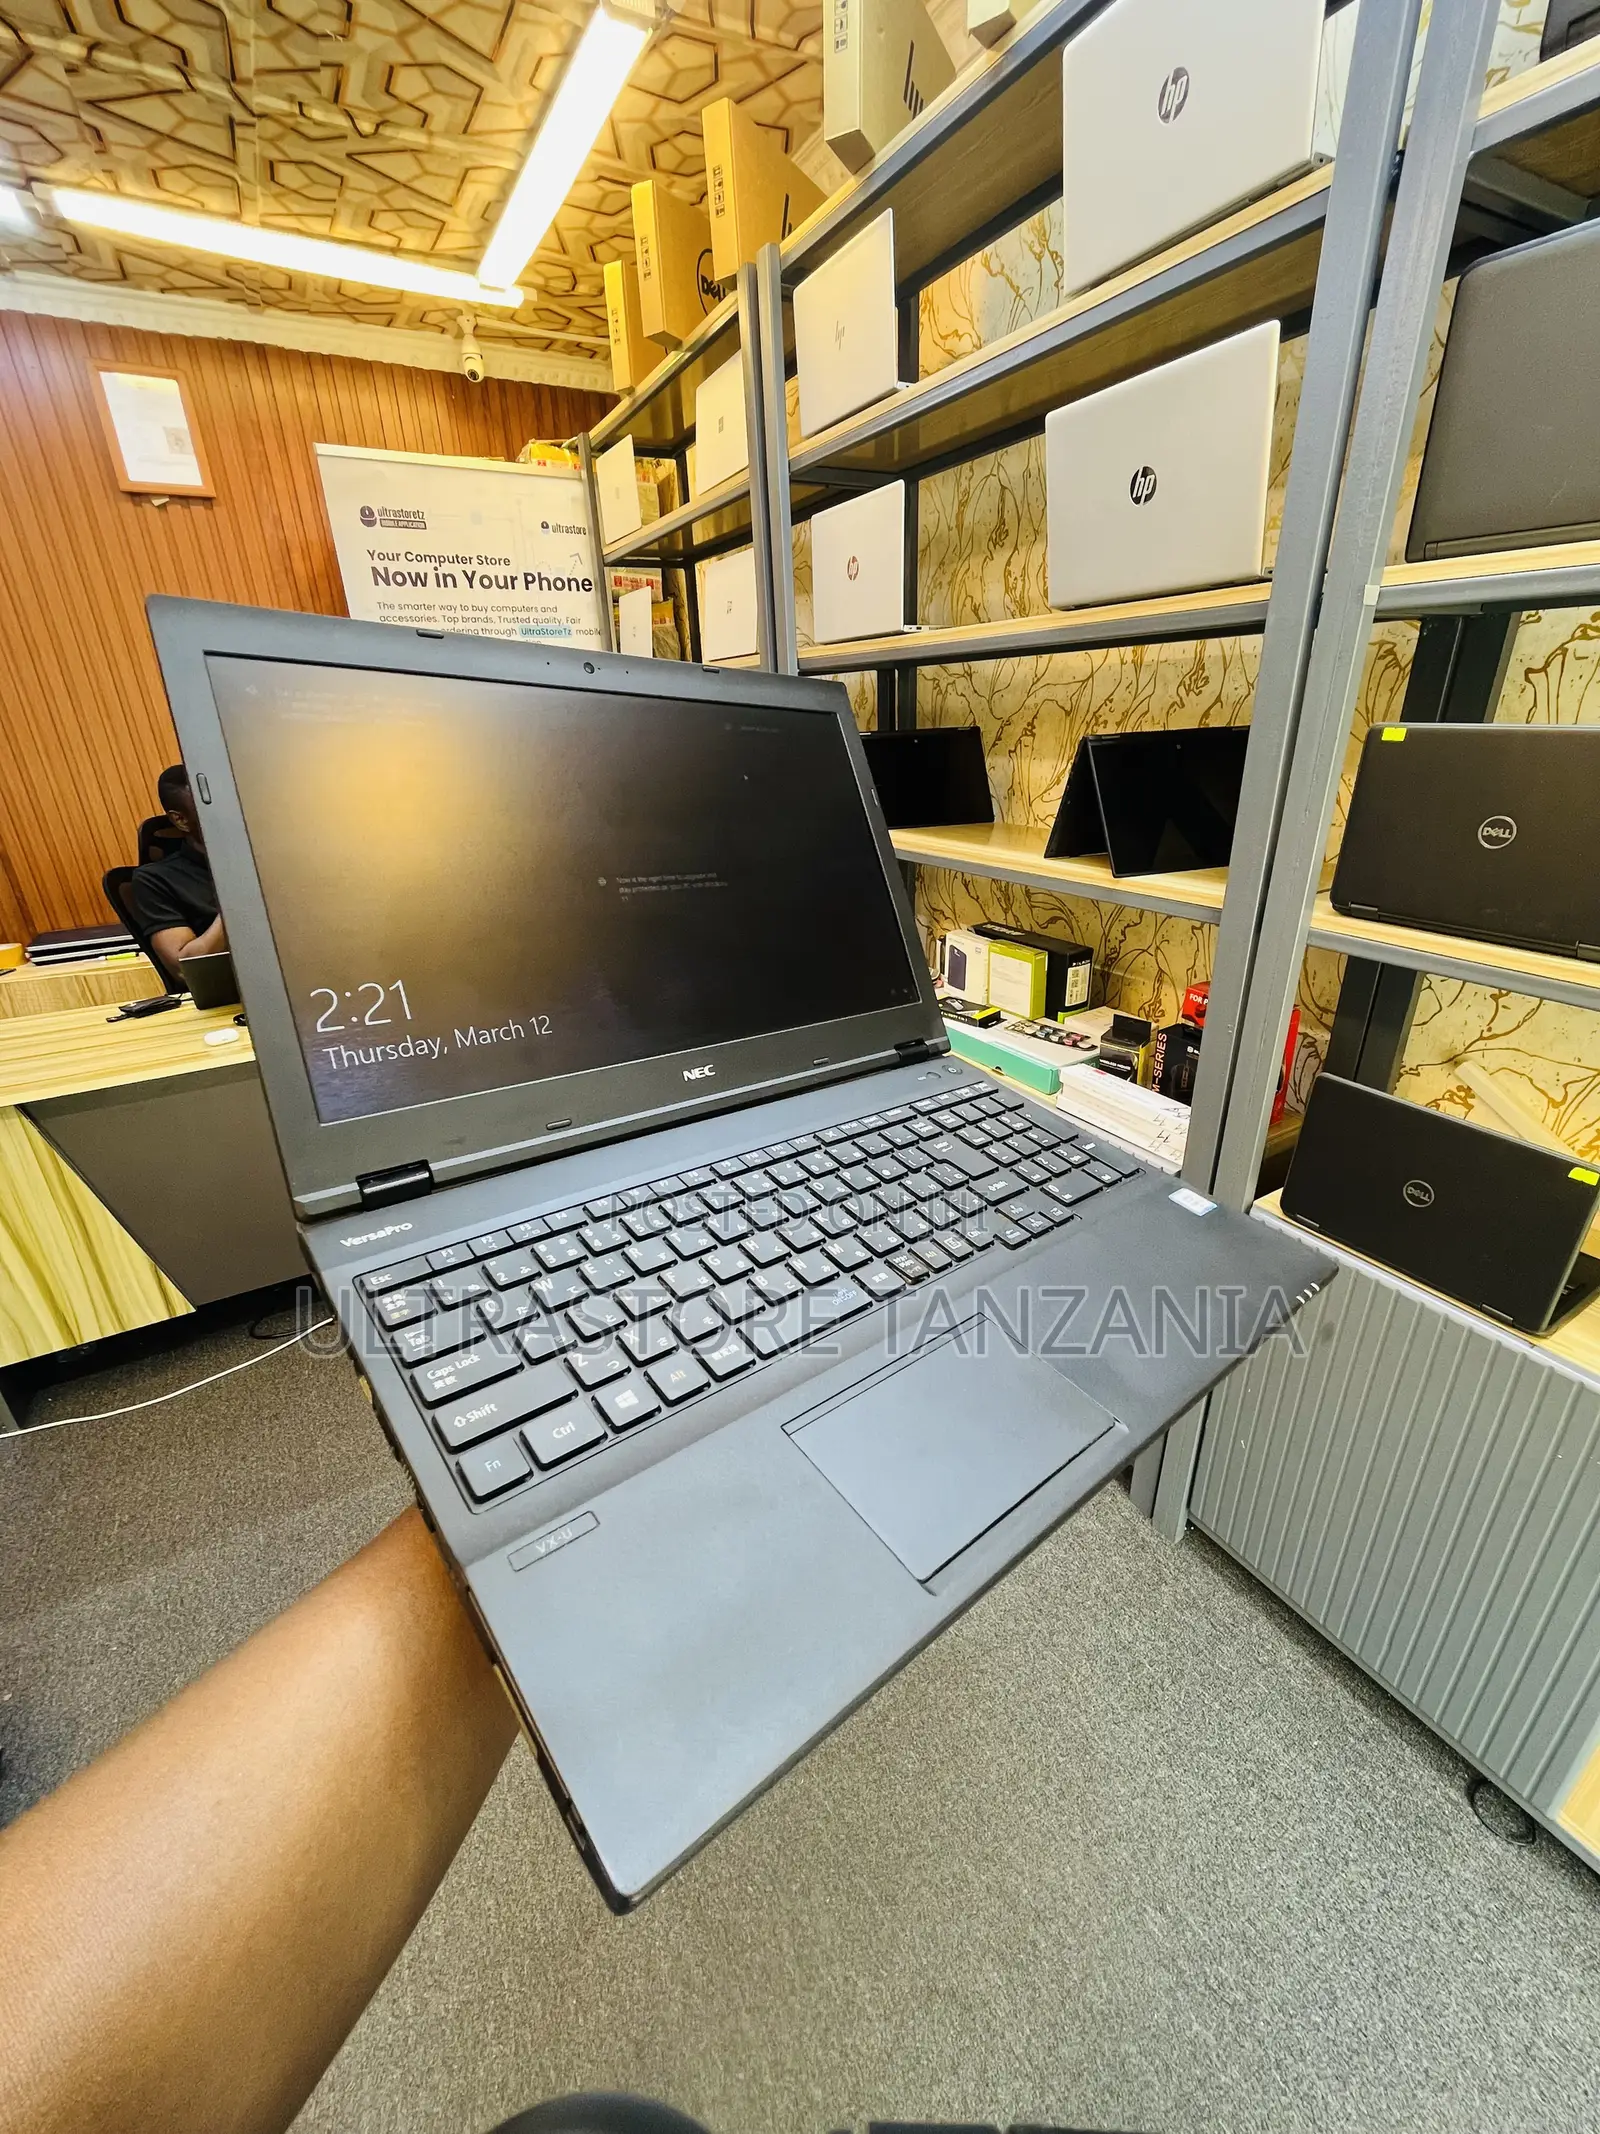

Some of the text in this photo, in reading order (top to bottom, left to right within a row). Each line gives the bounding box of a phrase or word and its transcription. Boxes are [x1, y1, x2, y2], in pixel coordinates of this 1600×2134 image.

[1129, 466, 1158, 507] hp
[367, 549, 511, 567] Your Computer Store
[371, 566, 593, 592] Now in Your Phone
[377, 601, 557, 614] The smarter way to buy computers and
[379, 614, 440, 623] accessories.
[441, 615, 459, 624] Top
[461, 615, 496, 624] brands,
[497, 616, 531, 624] Trusted
[566, 616, 581, 624] Fair
[481, 627, 516, 637] through
[1482, 826, 1512, 839] DELL
[1189, 993, 1203, 1005] FOR
[309, 980, 413, 1033] 2:21
[322, 1015, 553, 1071] Thursday, March 12
[1151, 1033, 1168, 1093] M-SERIES
[681, 1064, 716, 1082] NEC
[1406, 1186, 1431, 1202] DELL
[815, 1213, 828, 1223] K
[340, 1222, 413, 1247] VersaPro
[670, 1232, 681, 1243] T
[746, 1239, 760, 1250] H
[827, 1243, 844, 1255] M
[545, 1254, 557, 1264] 3
[628, 1247, 643, 1259] R
[707, 1255, 720, 1267] G
[790, 1260, 808, 1271] N
[583, 1263, 598, 1274] E
[370, 1273, 392, 1285] Esc
[496, 1272, 508, 1282] 2
[755, 1275, 769, 1287] B
[534, 1278, 554, 1292] W
[623, 1330, 640, 1344] X
[573, 1352, 588, 1367] Z
[426, 1353, 481, 1380] Caps Lock
[669, 1370, 687, 1383] Alt
[466, 1403, 498, 1423] Shift
[552, 1421, 576, 1439] Ctrl
[484, 1458, 501, 1473] Fn
[535, 1527, 573, 1554] VX-U
